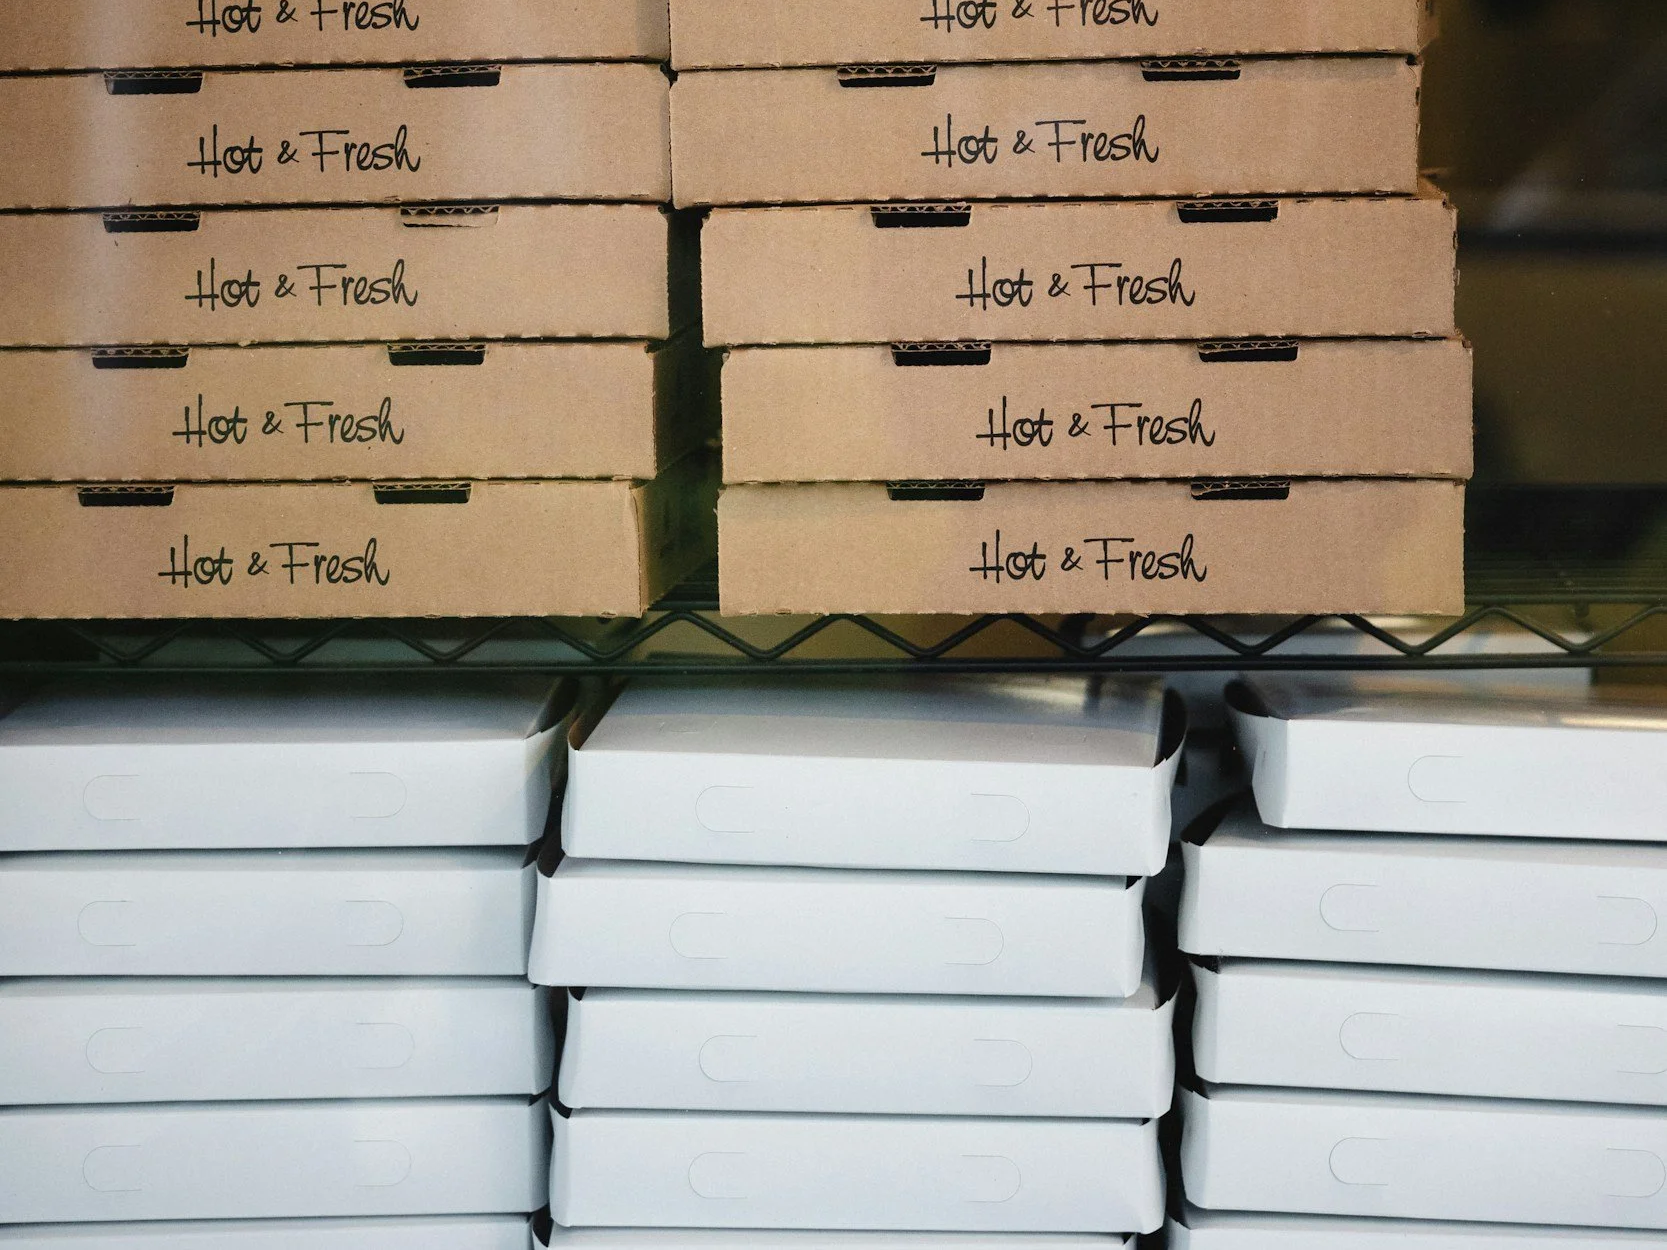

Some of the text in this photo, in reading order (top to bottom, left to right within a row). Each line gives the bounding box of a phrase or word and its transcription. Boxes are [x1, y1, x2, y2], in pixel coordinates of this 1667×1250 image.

[186, 123, 422, 179] Hot & Fresh
[920, 112, 1160, 169] Hot & Fresh
[184, 256, 419, 312] Hot & Fresh
[954, 255, 1196, 312] Hot & Fresh
[171, 393, 405, 449] Hot & Fresh
[975, 395, 1216, 451] Hot & Fresh
[157, 533, 391, 589] Hot & Fresh
[968, 528, 1208, 585] Hot & Fresh
